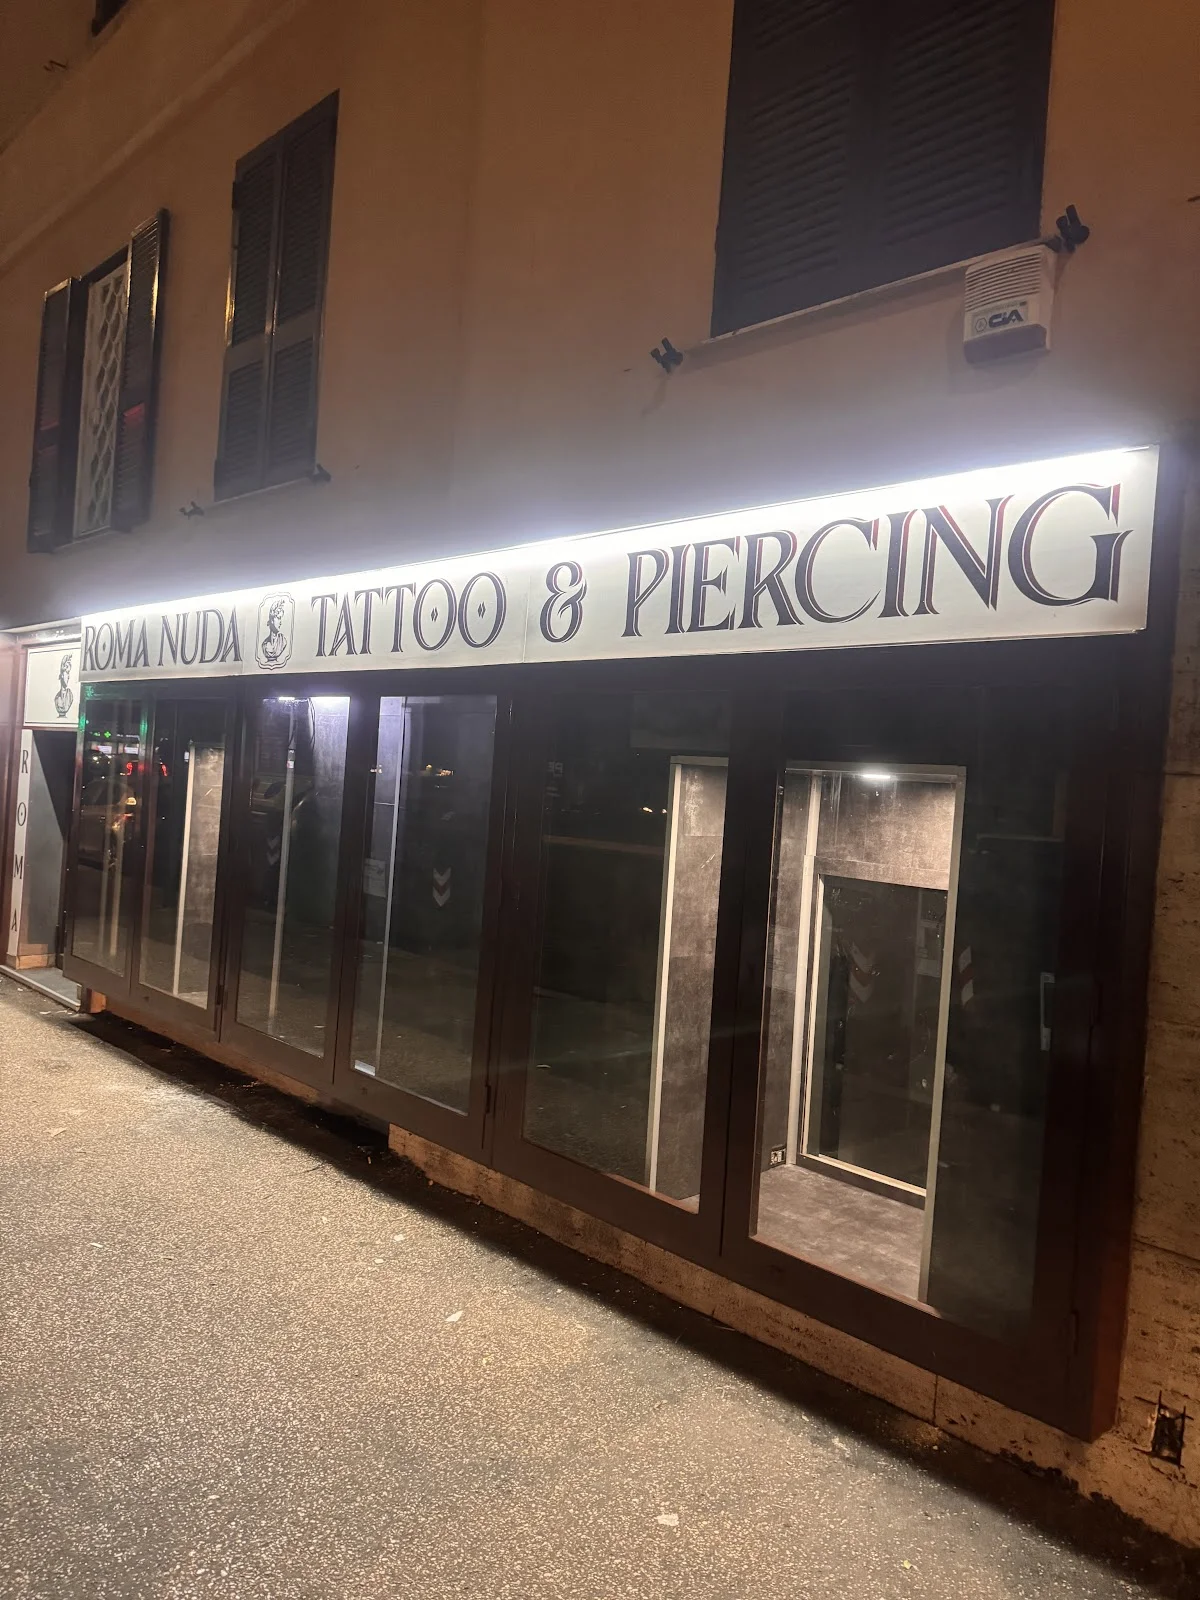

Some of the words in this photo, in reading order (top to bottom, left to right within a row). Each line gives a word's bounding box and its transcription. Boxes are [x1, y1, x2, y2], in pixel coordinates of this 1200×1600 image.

[82, 616, 149, 671] ROMA
[158, 606, 242, 666] NUDA
[311, 573, 506, 658] TATTOO
[540, 561, 587, 643] &
[620, 483, 1134, 637] PIERCING
[11, 749, 29, 932] ROMA
